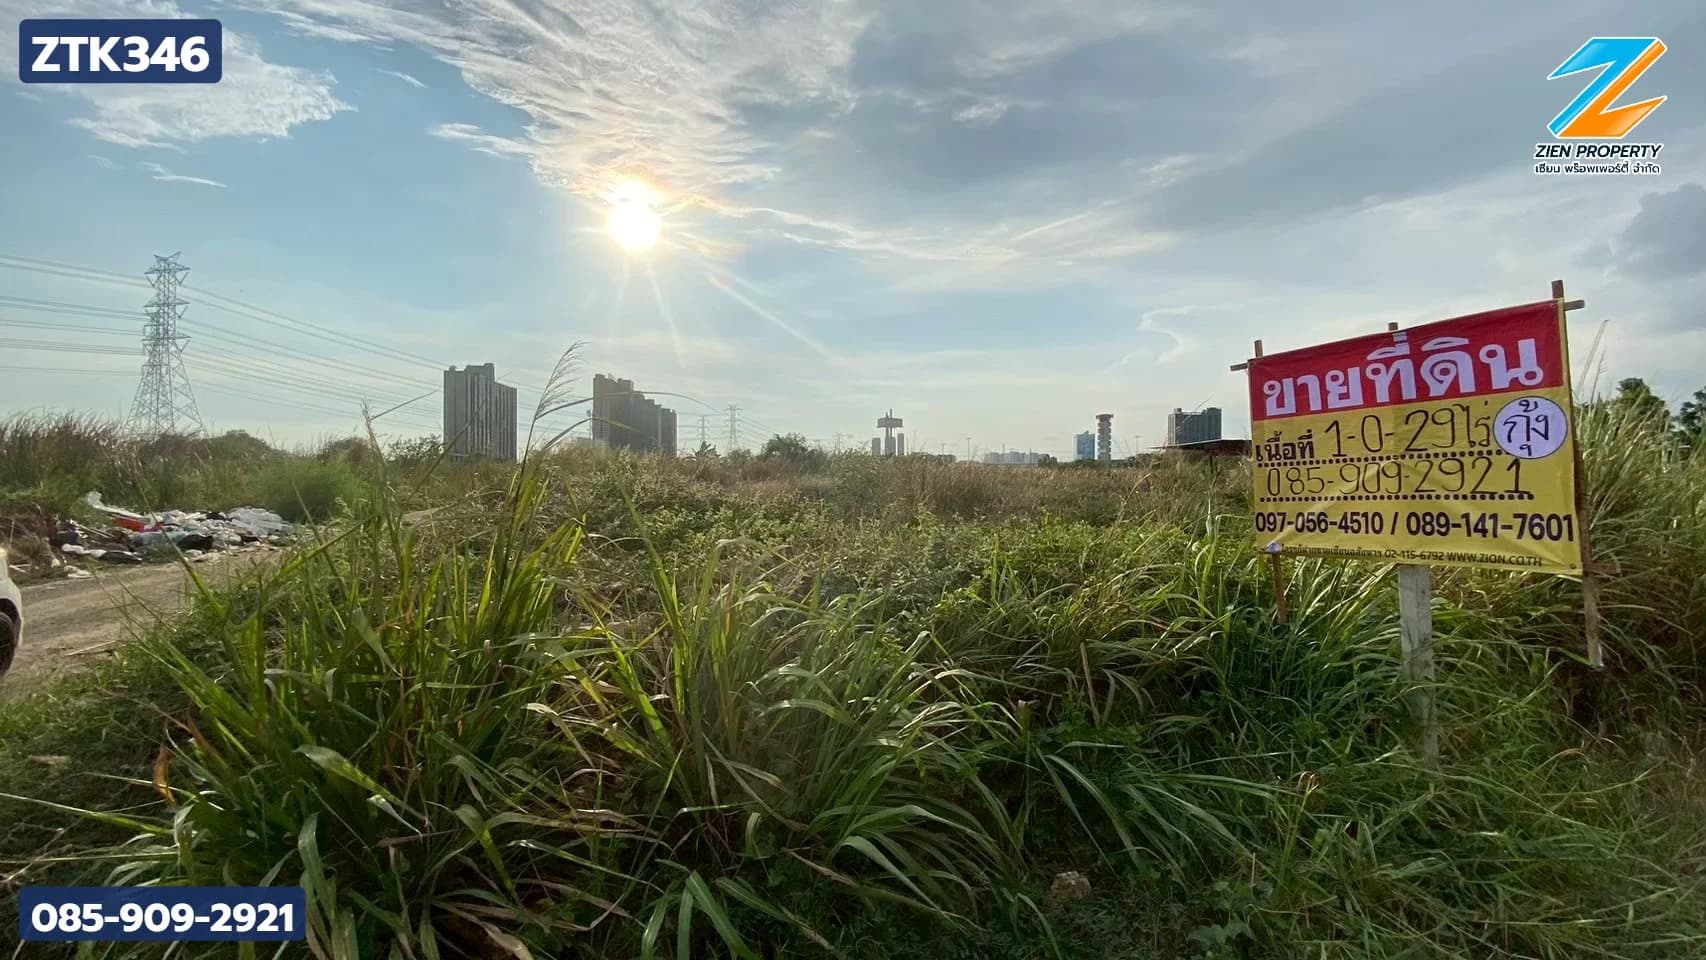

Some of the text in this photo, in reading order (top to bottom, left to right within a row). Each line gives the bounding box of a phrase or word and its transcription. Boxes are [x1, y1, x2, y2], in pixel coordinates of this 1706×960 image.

[1262, 330, 1544, 417] ขายที่ดิน
[1255, 429, 1315, 462] เนื้อที่
[1255, 511, 1574, 542] 097-056-4510 / 089-141-7601
[1384, 549, 1444, 562] 02-115-6792
